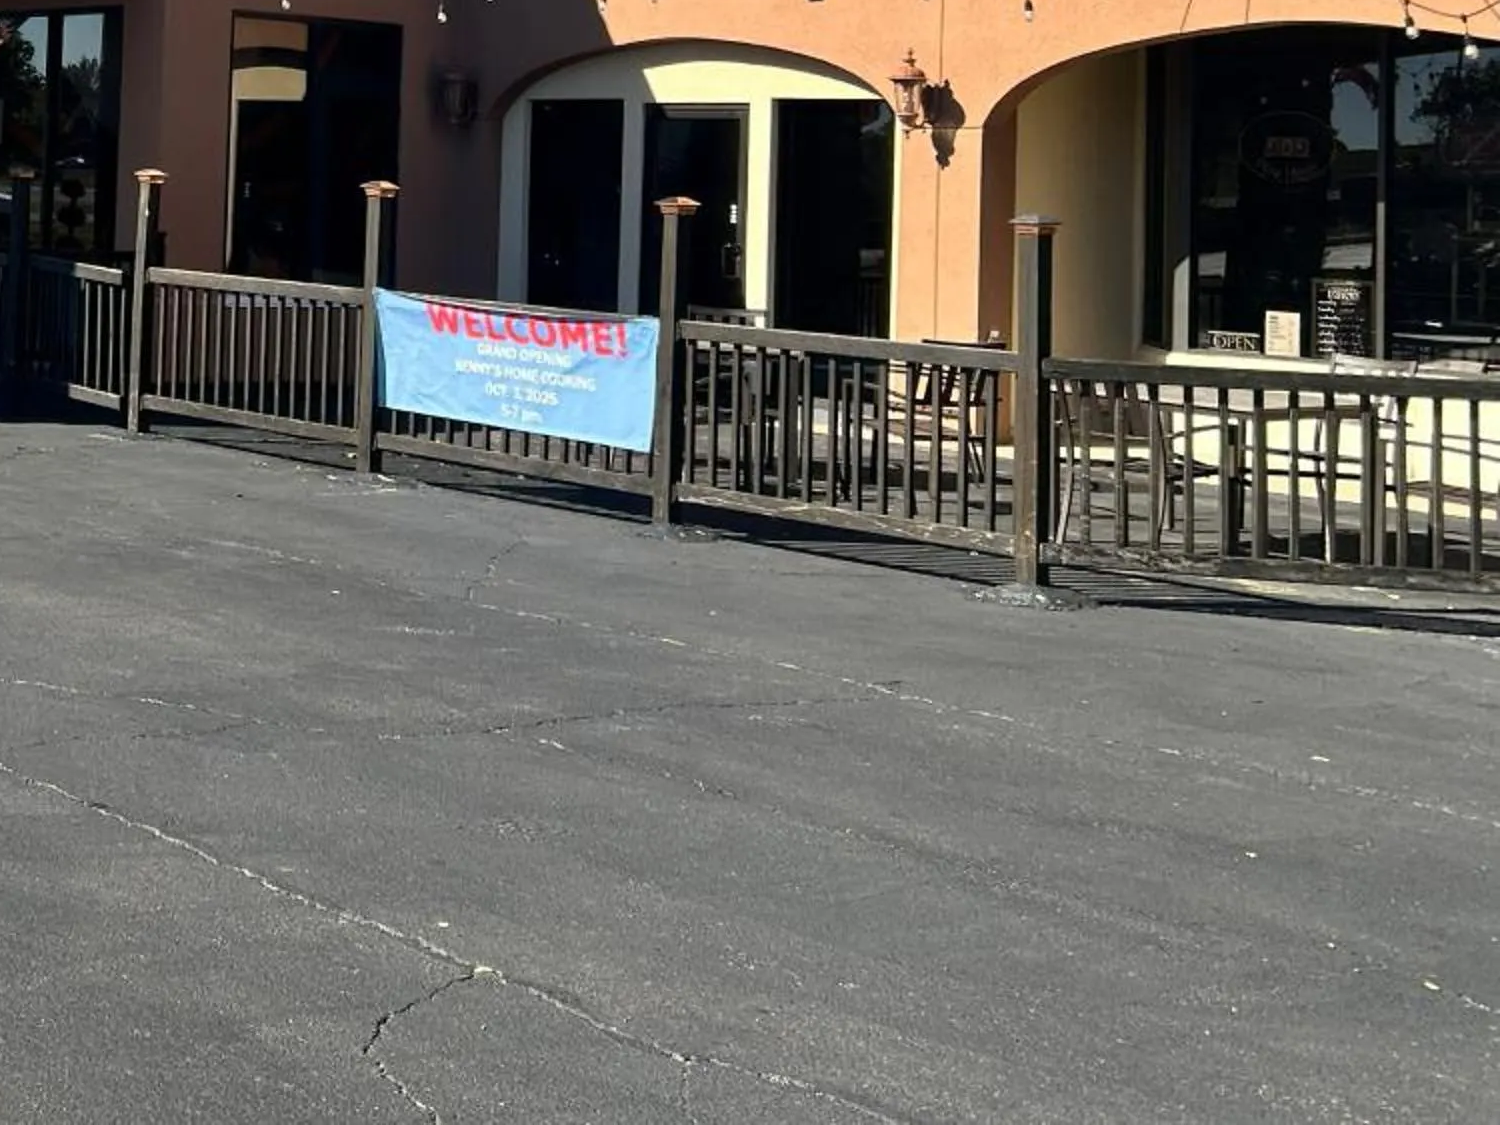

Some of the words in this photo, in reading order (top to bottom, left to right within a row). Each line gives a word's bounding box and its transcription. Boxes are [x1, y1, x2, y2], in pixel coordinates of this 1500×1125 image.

[425, 302, 629, 358] WELCOME!
[1212, 334, 1255, 350] OPEN
[477, 343, 517, 360] GRAND
[520, 349, 572, 368] OPENING
[503, 366, 539, 383] HOME
